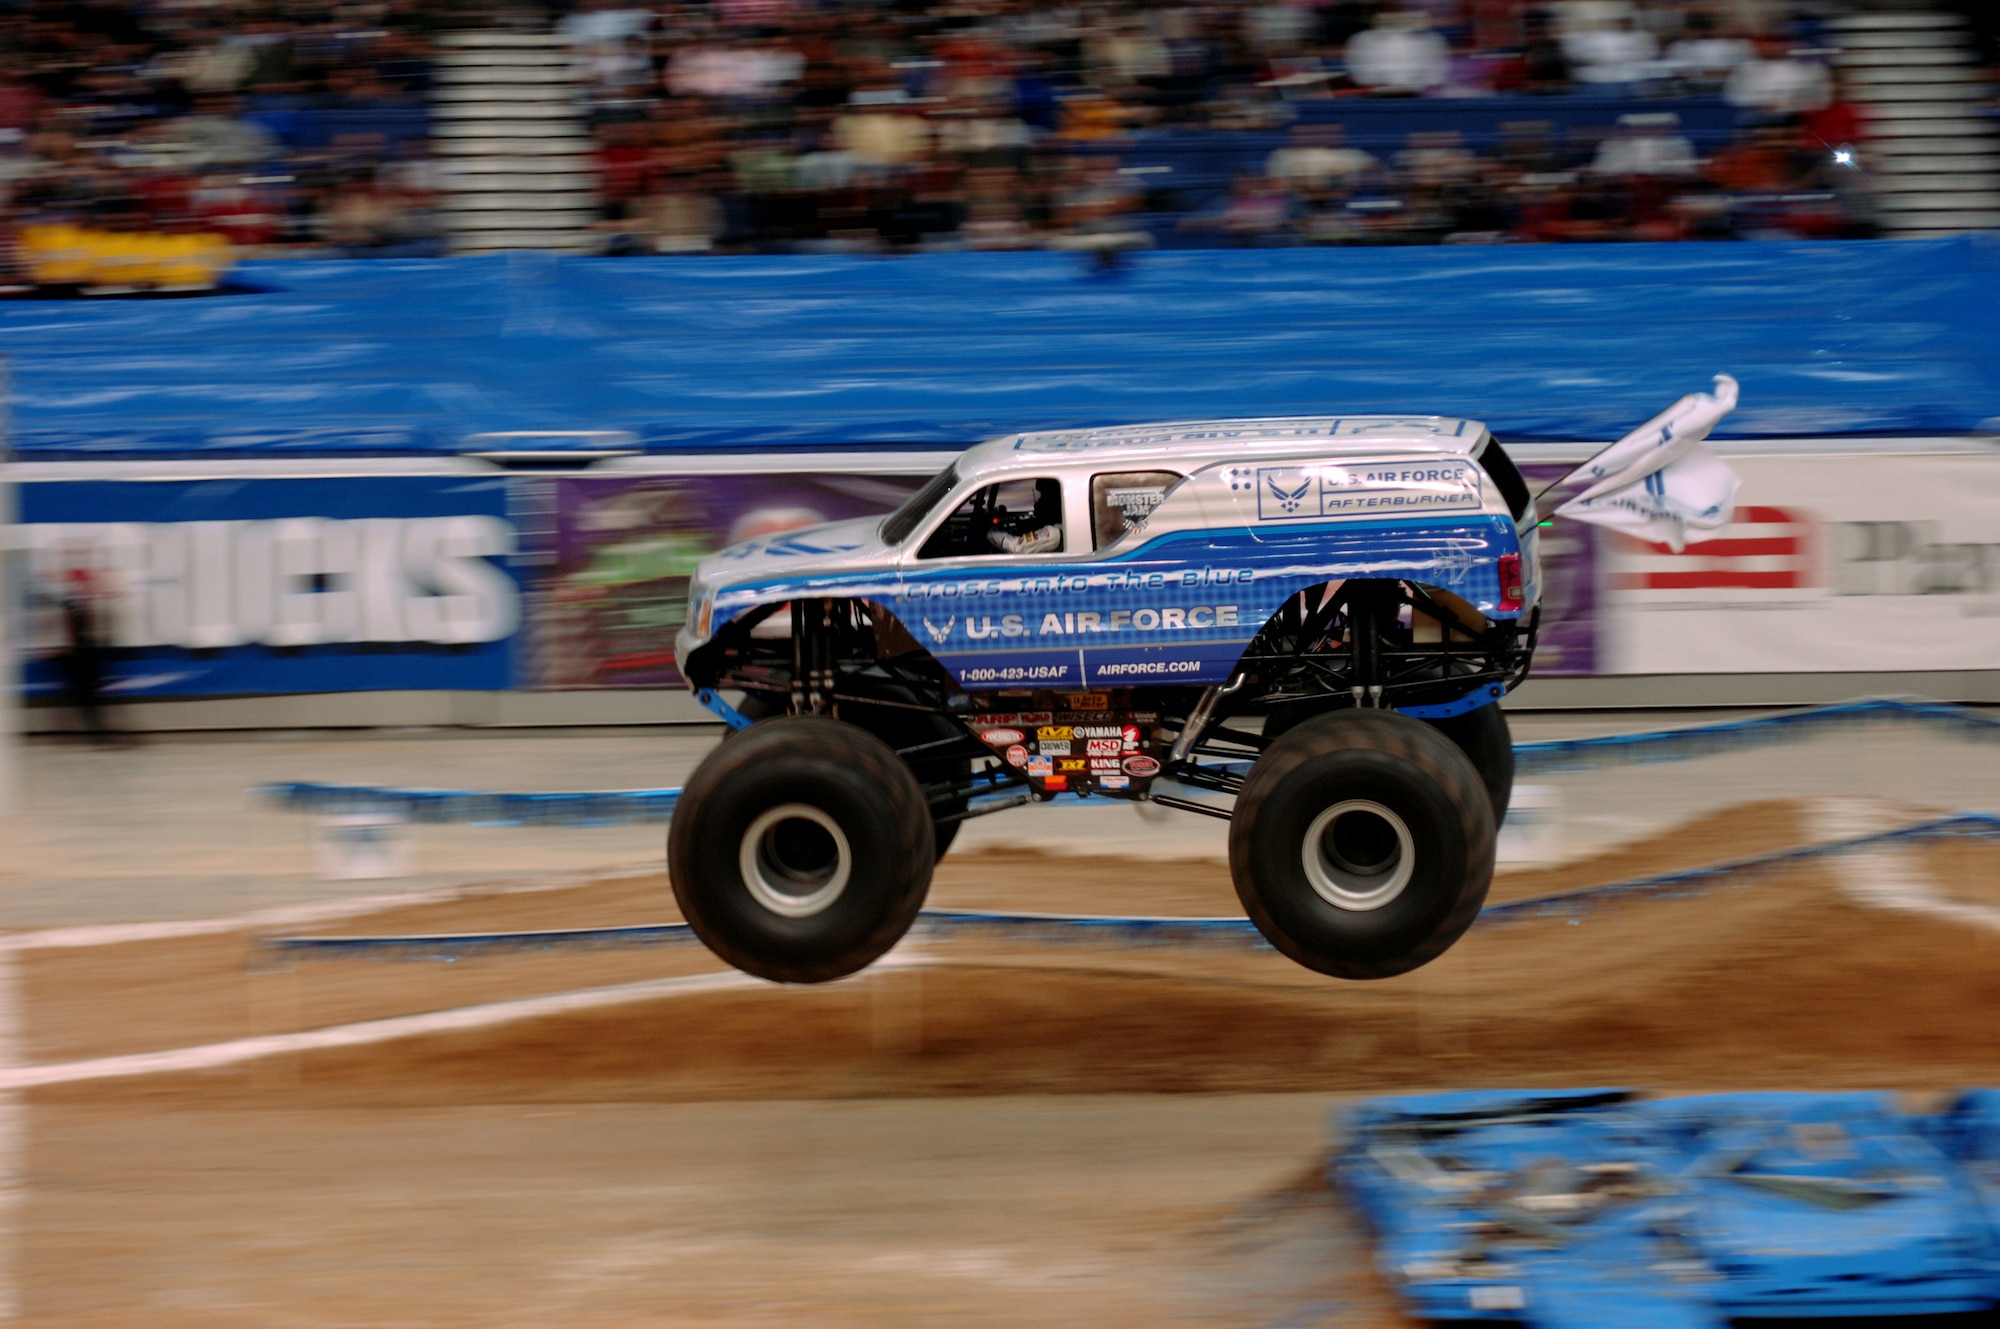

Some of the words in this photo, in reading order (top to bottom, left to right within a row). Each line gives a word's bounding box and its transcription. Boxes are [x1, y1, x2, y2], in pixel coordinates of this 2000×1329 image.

[1367, 472, 1397, 482] AIR
[1400, 469, 1464, 482] FORCE
[1107, 494, 1164, 507] MONSTER
[1328, 494, 1474, 508] AFTERBURNER
[1123, 505, 1150, 516] JAM
[965, 614, 1031, 640] U.S.
[1038, 611, 1101, 636] AIR
[1110, 605, 1240, 632] FORCE
[960, 665, 1069, 682] 1-800-423-USAF
[1097, 661, 1201, 676] AIRFORCE.COM
[976, 713, 1018, 725] ARP
[1084, 726, 1123, 738] YAMAHA
[1041, 742, 1070, 751] CROWER
[1089, 740, 1119, 751] MSD
[1090, 758, 1121, 769] KING
